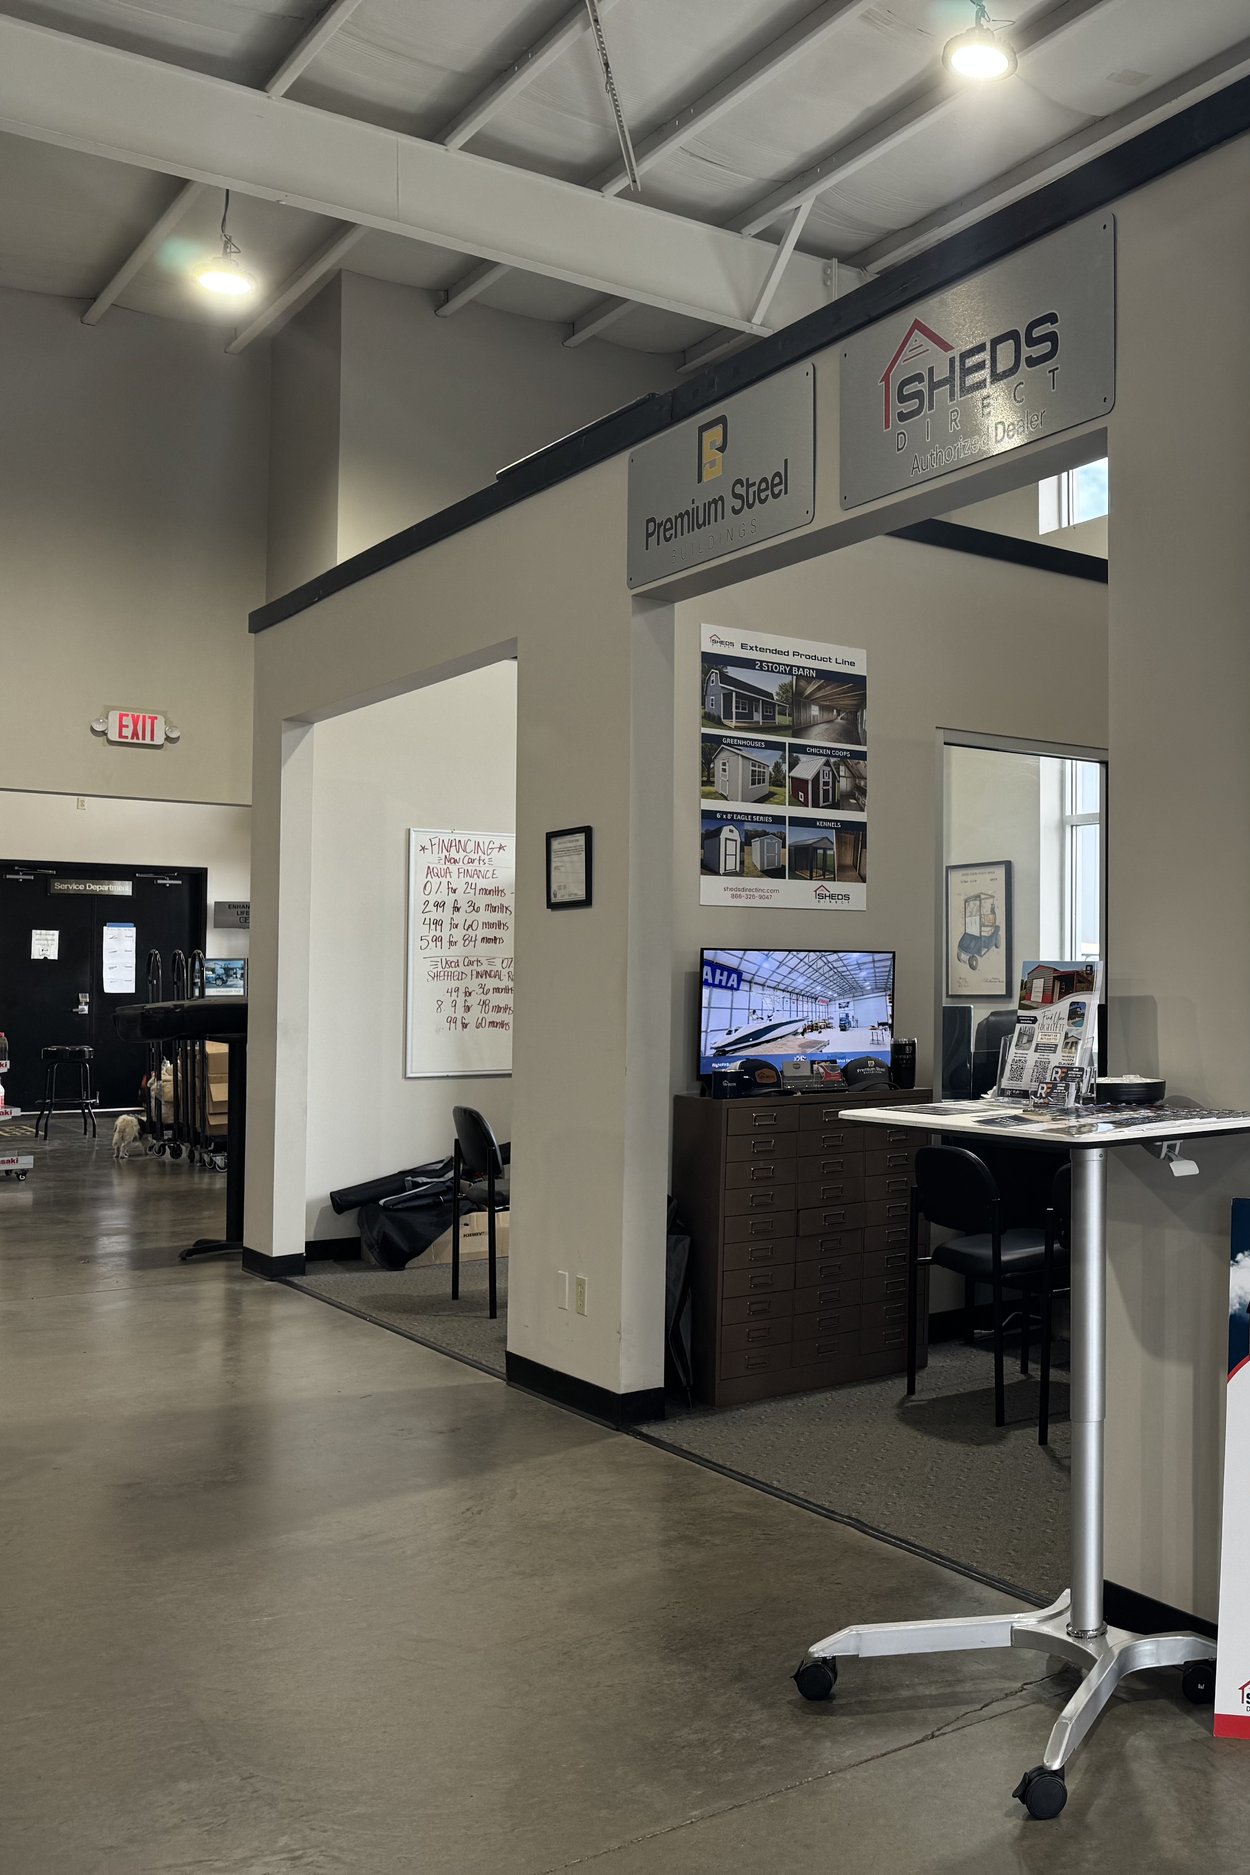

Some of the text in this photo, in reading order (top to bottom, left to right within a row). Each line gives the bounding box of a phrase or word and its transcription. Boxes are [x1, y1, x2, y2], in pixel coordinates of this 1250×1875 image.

[896, 311, 1060, 424] SHEDS
[896, 366, 1060, 453] DIRECT
[910, 409, 1046, 477] Authorized Dealer
[644, 458, 789, 551] Premium Steel
[740, 643, 789, 657] Extended
[792, 651, 832, 663] Product
[835, 657, 856, 667] Line
[755, 661, 816, 677] 2 STORY BARN
[118, 712, 158, 742] EXIT
[722, 738, 765, 748] GREENHOUSES
[806, 747, 851, 757] CHICKEN COOPS
[733, 814, 751, 822] EAGLE
[429, 836, 496, 856] FINANCING
[462, 855, 487, 866] Carts
[425, 866, 499, 880] AQUA FINANCE
[54, 882, 129, 892] Service Department
[447, 881, 458, 896] for
[463, 881, 477, 896] 24
[478, 886, 506, 898] months
[817, 893, 850, 901] SHEDS
[452, 899, 461, 915] for
[465, 900, 481, 914] 36
[484, 903, 512, 916] months
[449, 917, 459, 931] for
[463, 919, 479, 932] 60
[481, 920, 509, 931] months
[448, 934, 459, 950] for
[463, 933, 478, 948] 84
[481, 936, 504, 944] months
[463, 956, 483, 967] Carts
[463, 987, 475, 998] for
[493, 985, 514, 994] month
[463, 999, 473, 1013] for
[477, 999, 490, 1014] 48
[461, 1016, 470, 1031] for
[475, 1017, 486, 1029] 60
[488, 1020, 510, 1031] months
